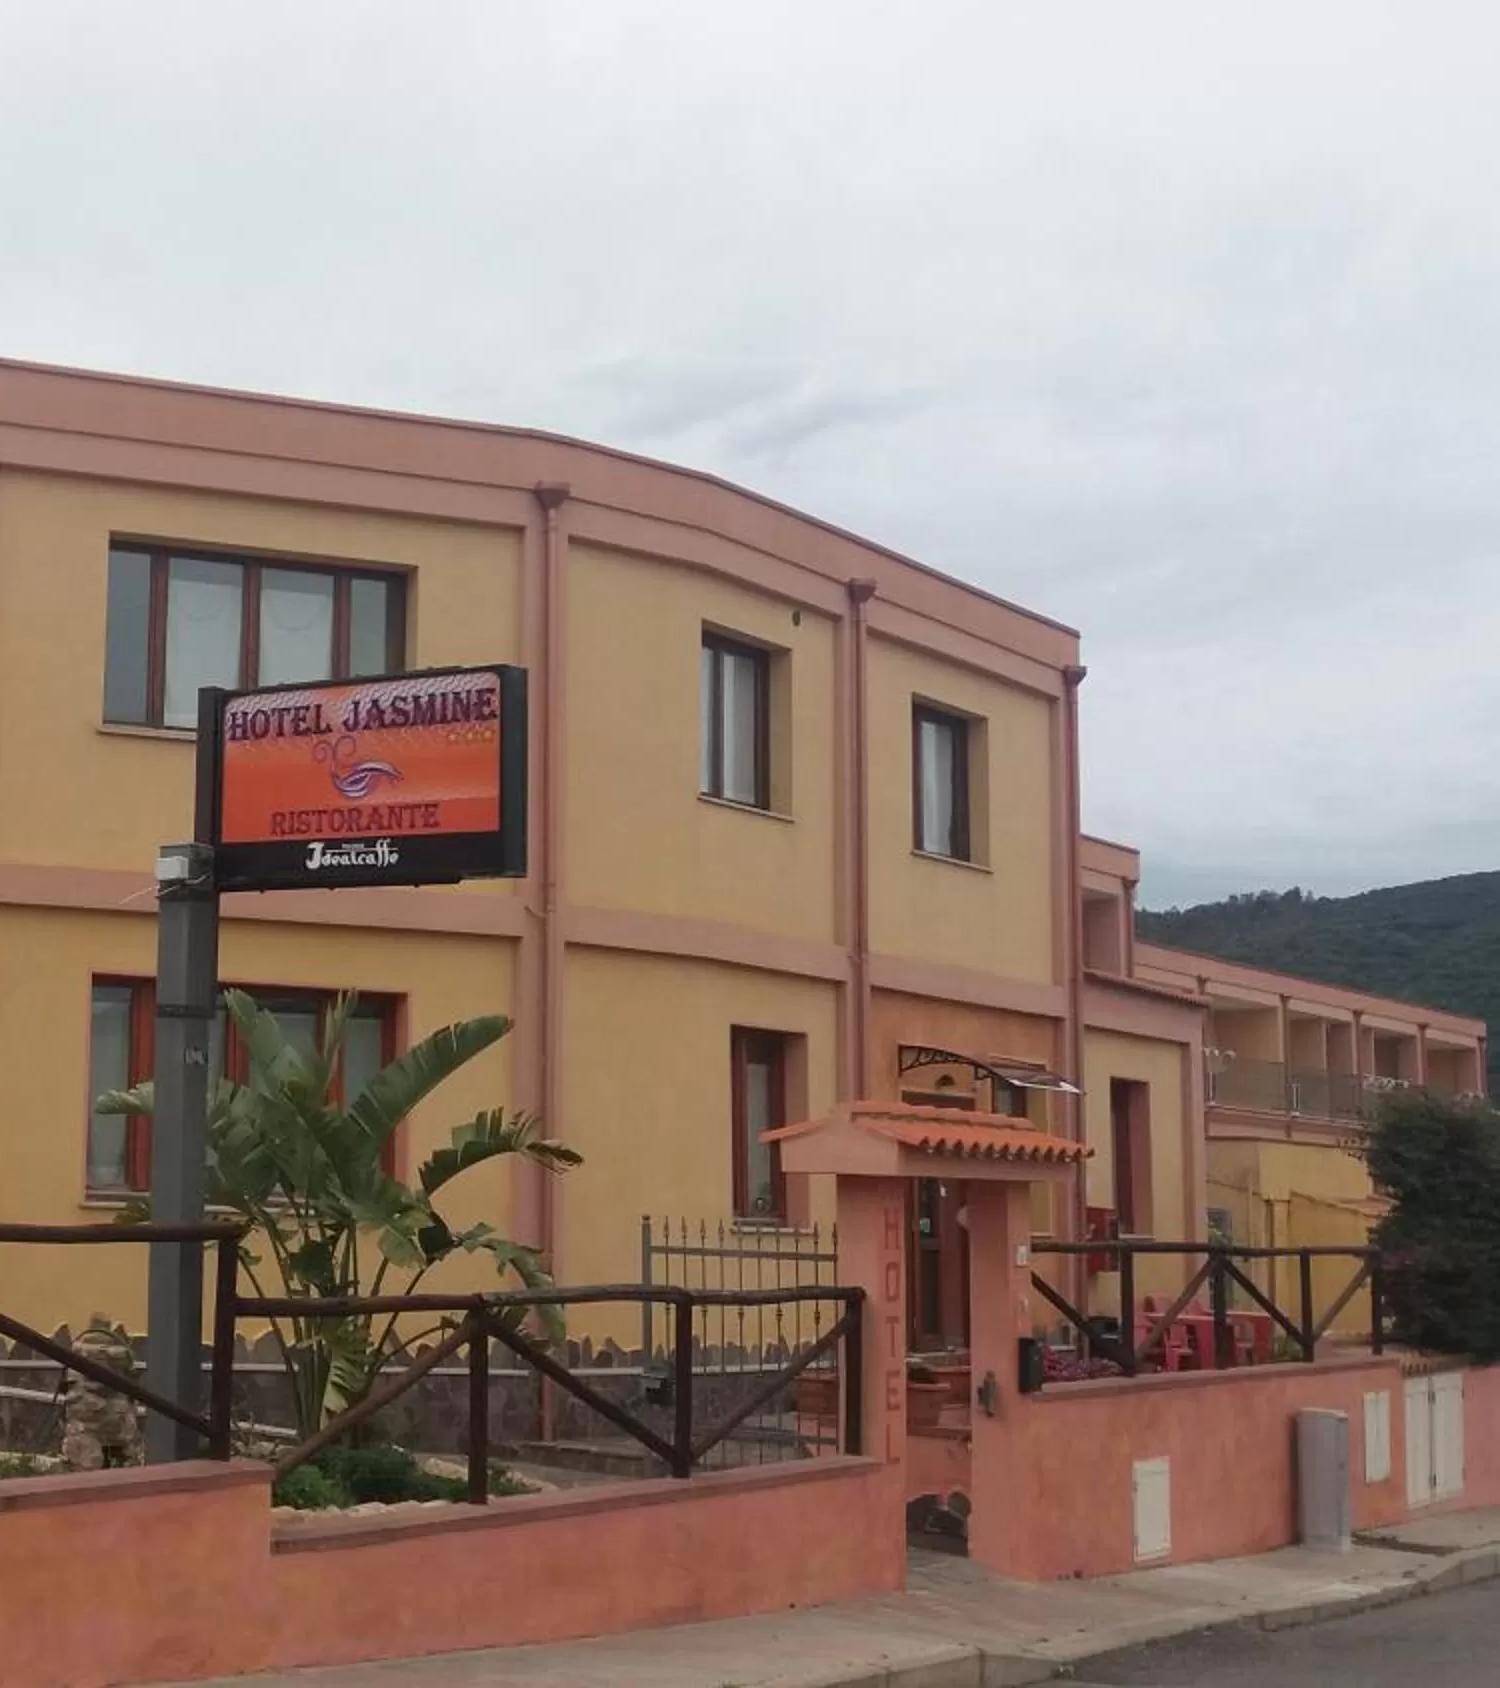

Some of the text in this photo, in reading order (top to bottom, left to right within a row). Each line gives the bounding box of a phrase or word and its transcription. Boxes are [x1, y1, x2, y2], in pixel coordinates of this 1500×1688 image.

[228, 687, 498, 742] HOTEL JASMINE
[269, 803, 441, 836] RISTORANTE
[883, 1207, 900, 1465] HOTEL
